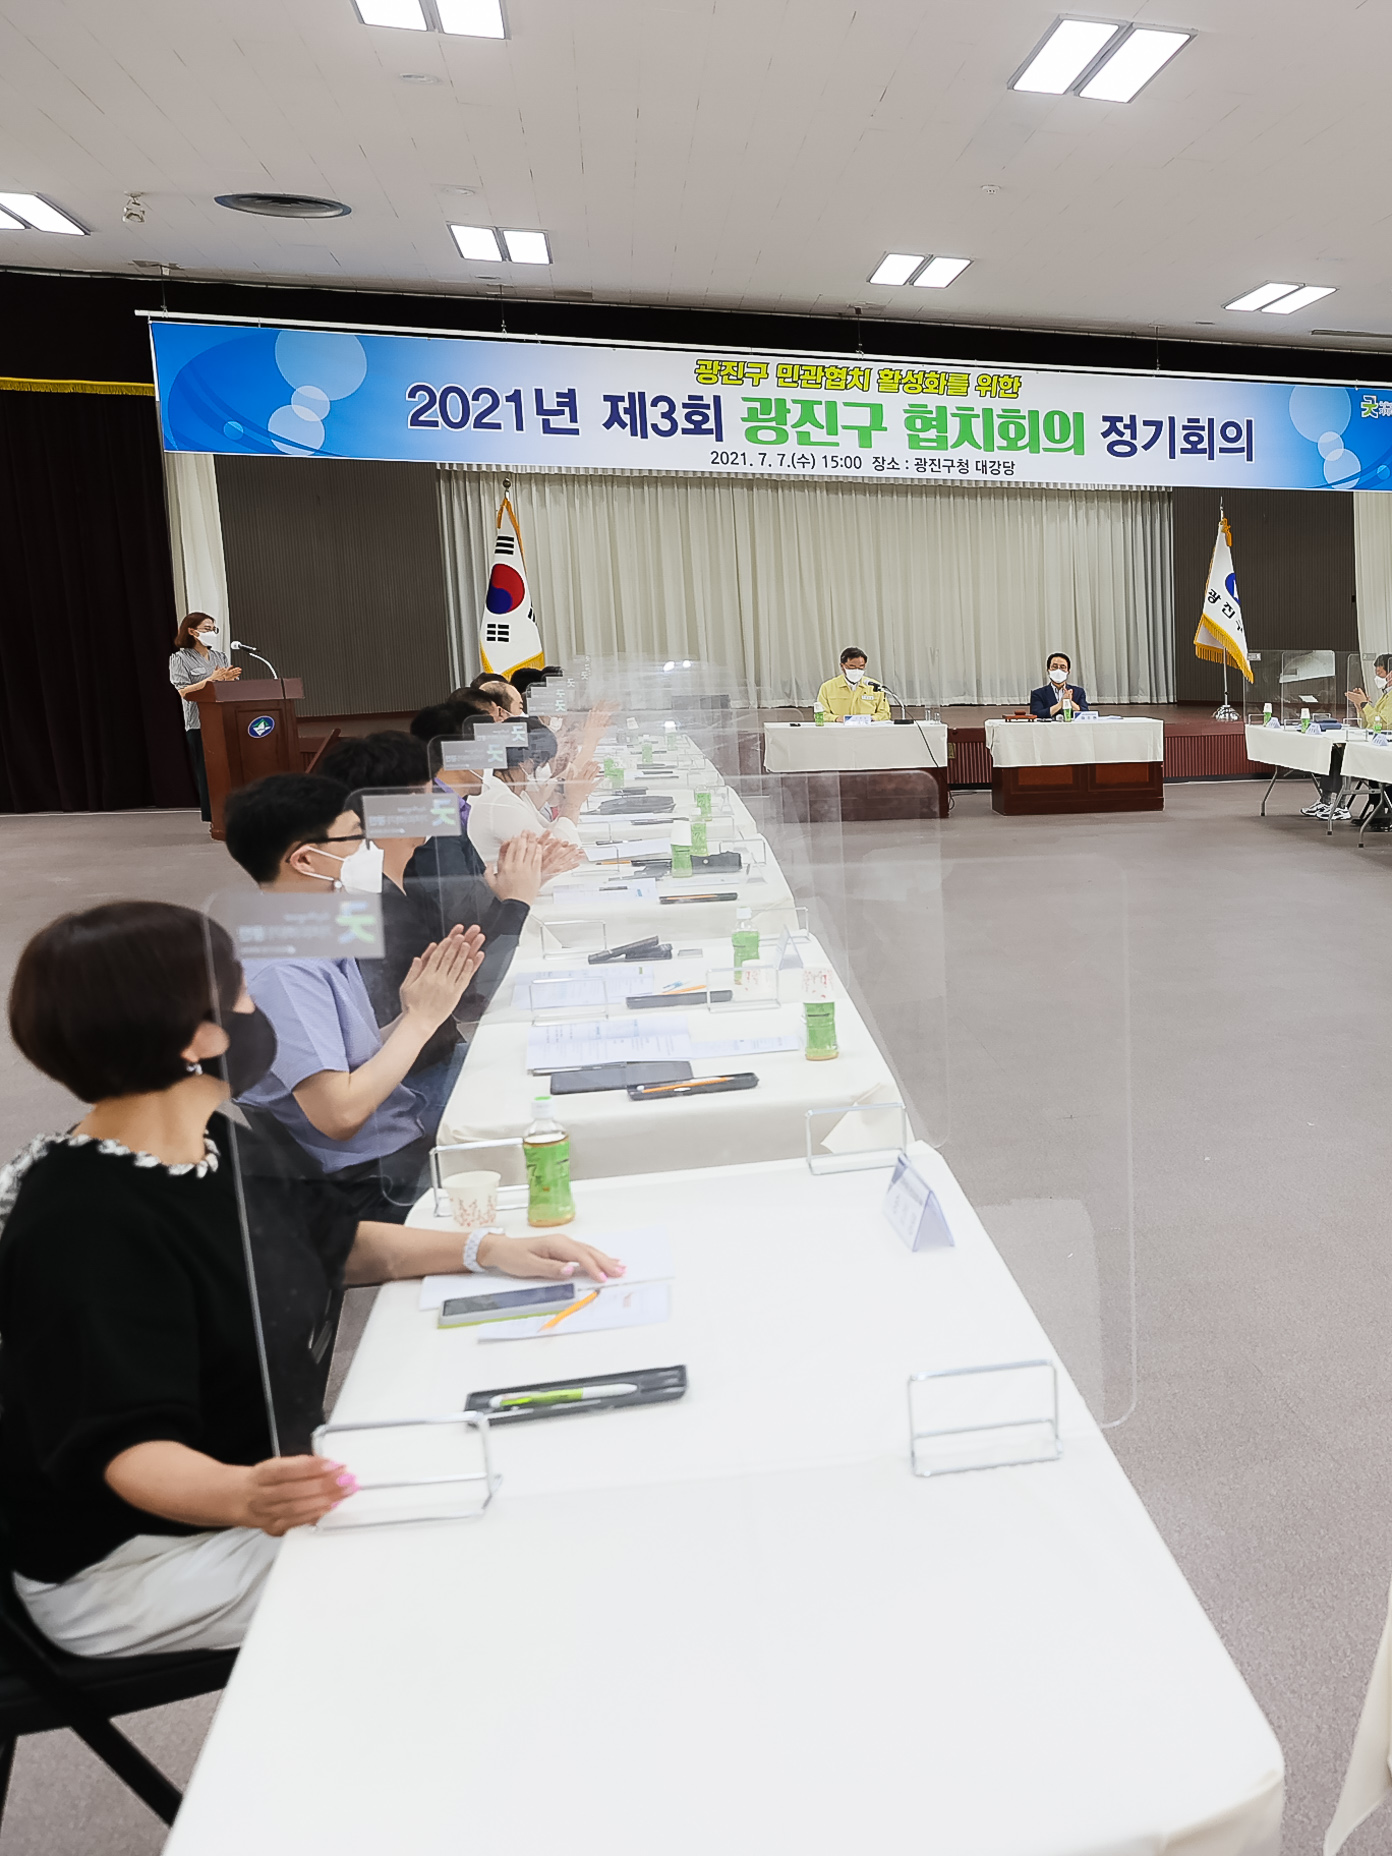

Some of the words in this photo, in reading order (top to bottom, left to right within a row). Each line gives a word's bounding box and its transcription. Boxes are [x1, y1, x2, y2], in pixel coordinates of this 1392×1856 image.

[694, 359, 770, 387] 광진구
[776, 363, 873, 392] 민관협치
[877, 368, 971, 397] 활성화를
[975, 373, 1022, 399] 위한
[405, 382, 580, 436] 2021년
[601, 391, 725, 442] 제3회
[740, 396, 888, 449] 광진구
[902, 403, 1085, 456] 협치회의
[1100, 414, 1254, 462] 정기회의
[710, 451, 754, 467] 2021.
[822, 455, 863, 469] 15:00
[872, 456, 901, 472] 장소
[914, 457, 970, 474] 광진구청
[975, 459, 1016, 476] 대강당
